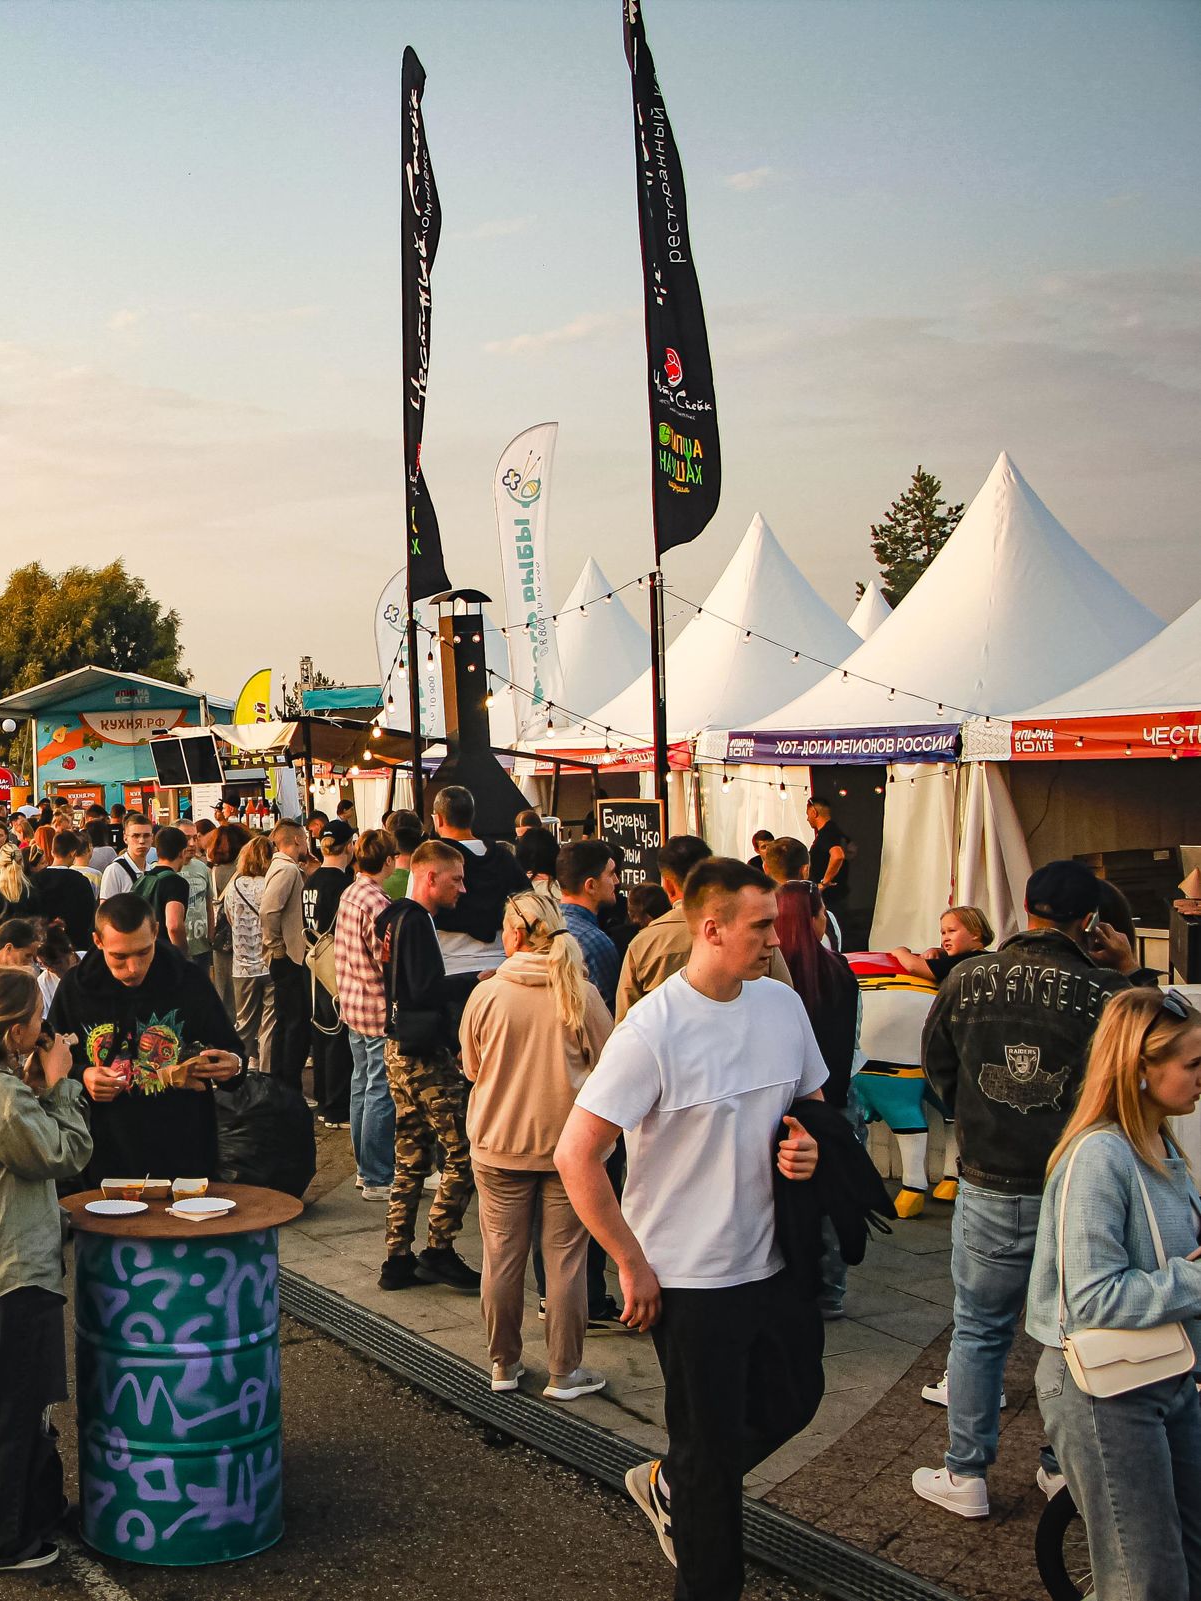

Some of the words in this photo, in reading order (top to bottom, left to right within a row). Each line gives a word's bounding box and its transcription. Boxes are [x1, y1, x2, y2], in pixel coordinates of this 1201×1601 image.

[652, 104, 687, 264] ресторанный
[100, 718, 166, 731] КУХНЯ.РФ
[775, 740, 832, 756] ХОТ-ДОГИ
[834, 738, 895, 754] РЕГИОНОВ
[896, 735, 953, 753] РОССИИ
[1015, 740, 1055, 753] ВОЛГЕ
[602, 808, 647, 840] Бургеры
[959, 963, 999, 1010] LOS
